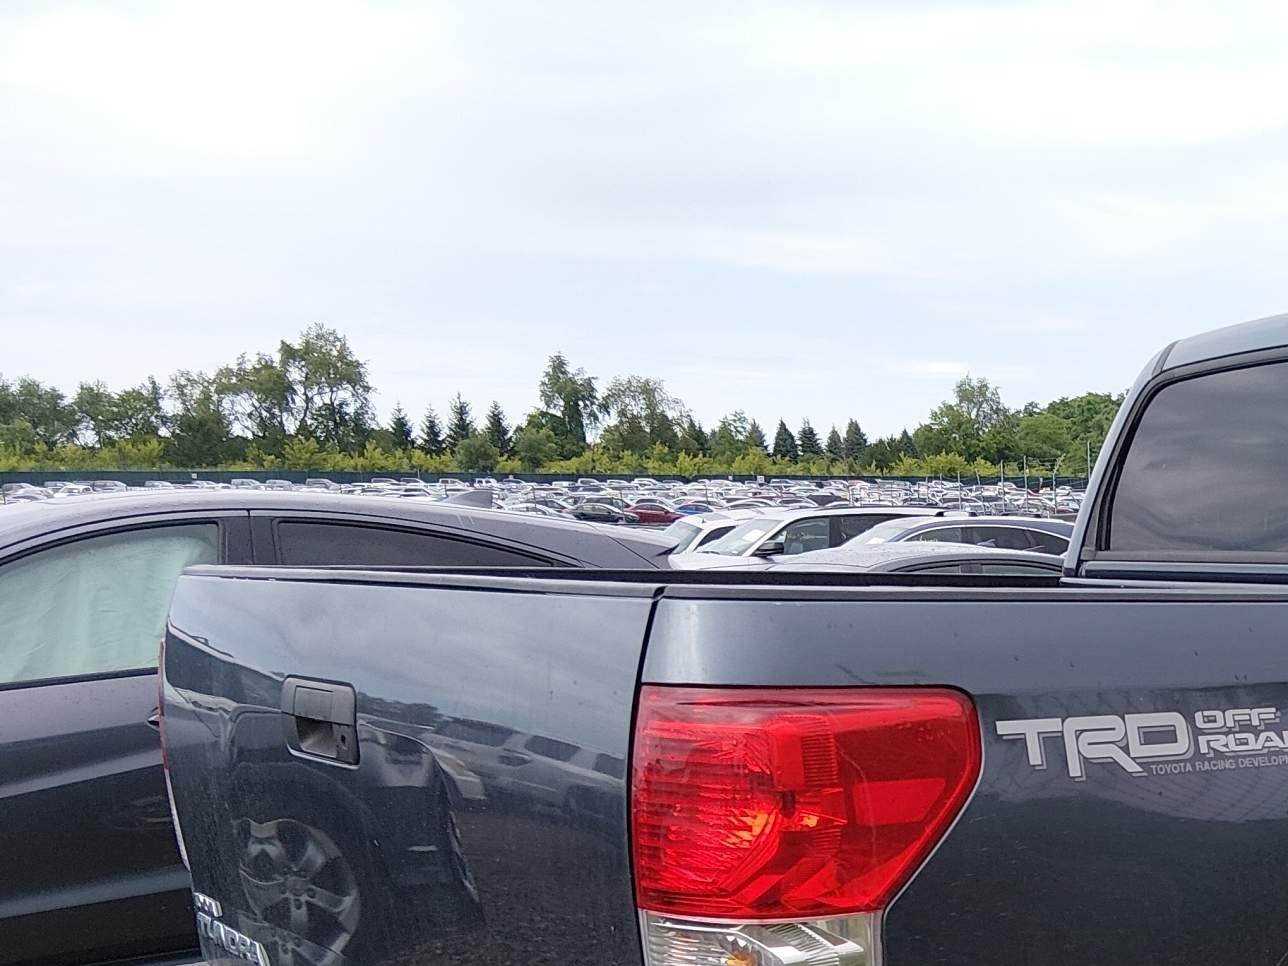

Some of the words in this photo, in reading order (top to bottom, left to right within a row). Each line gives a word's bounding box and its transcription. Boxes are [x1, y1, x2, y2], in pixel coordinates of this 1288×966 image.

[1194, 706, 1281, 734] OFF
[995, 711, 1194, 782] TRD
[1150, 761, 1193, 776] TOYOTA
[1194, 757, 1236, 772] RACING
